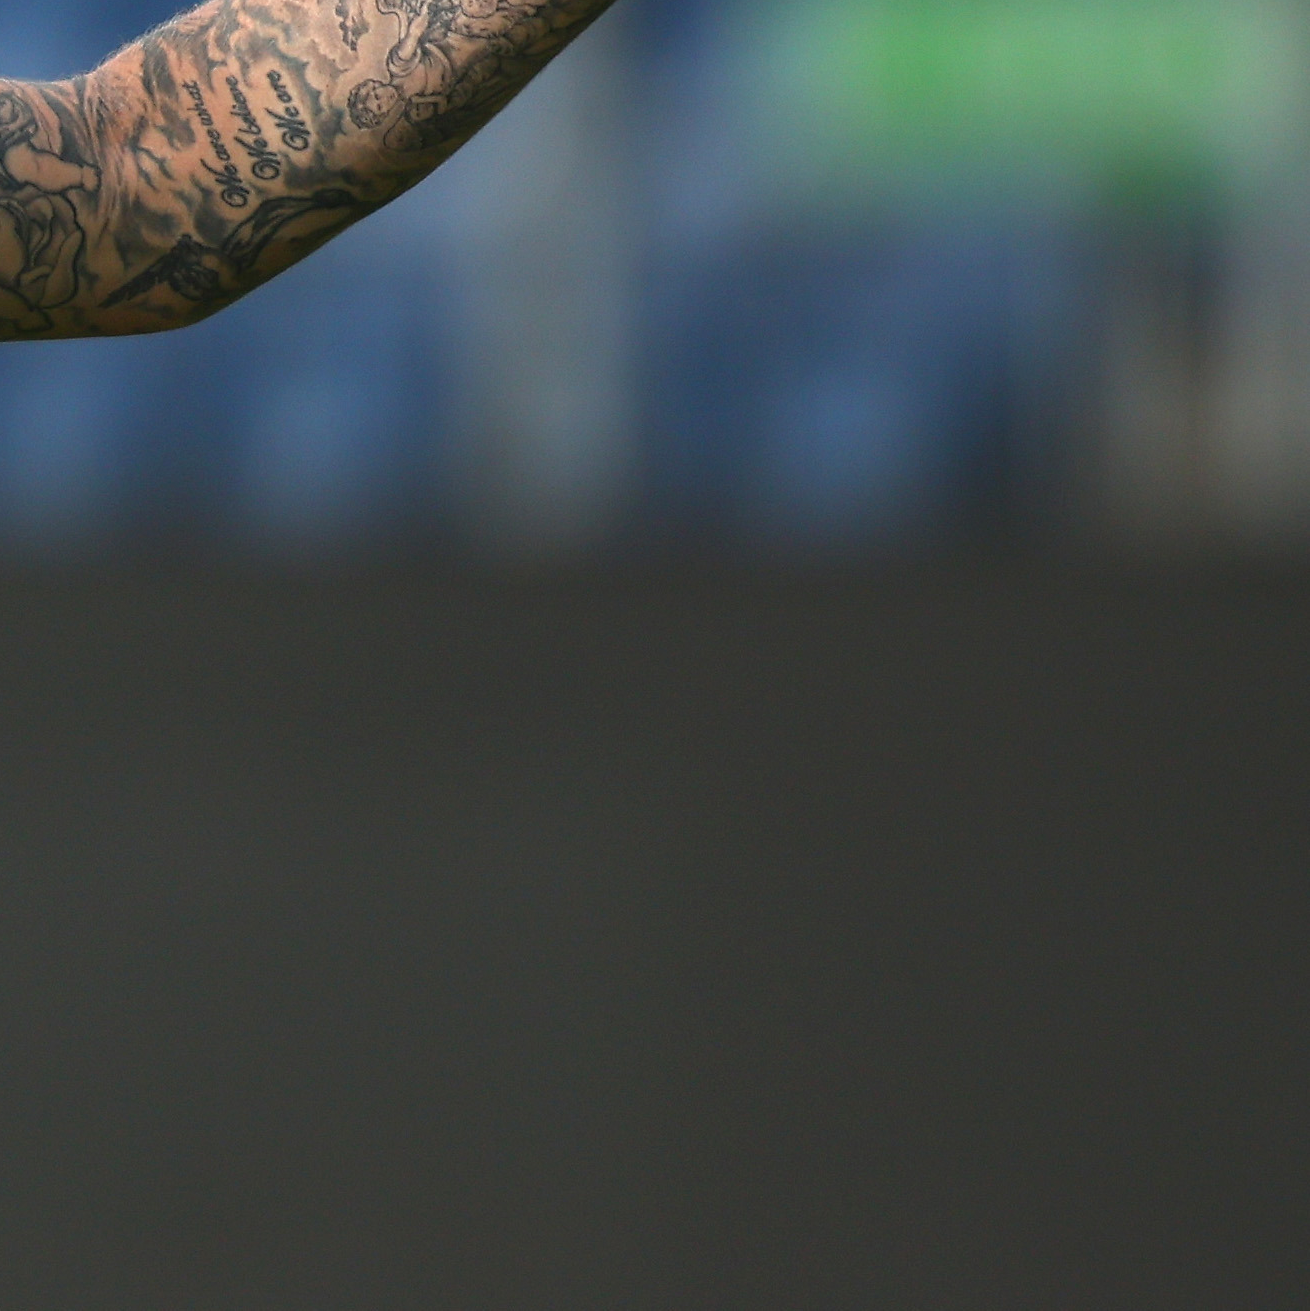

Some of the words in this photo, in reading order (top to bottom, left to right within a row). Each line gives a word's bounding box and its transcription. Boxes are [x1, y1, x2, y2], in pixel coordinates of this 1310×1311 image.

[182, 78, 215, 127] what
[266, 69, 293, 103] are
[207, 127, 232, 162] are
[266, 106, 312, 152] We
[234, 136, 281, 180] We
[200, 157, 250, 208] We
